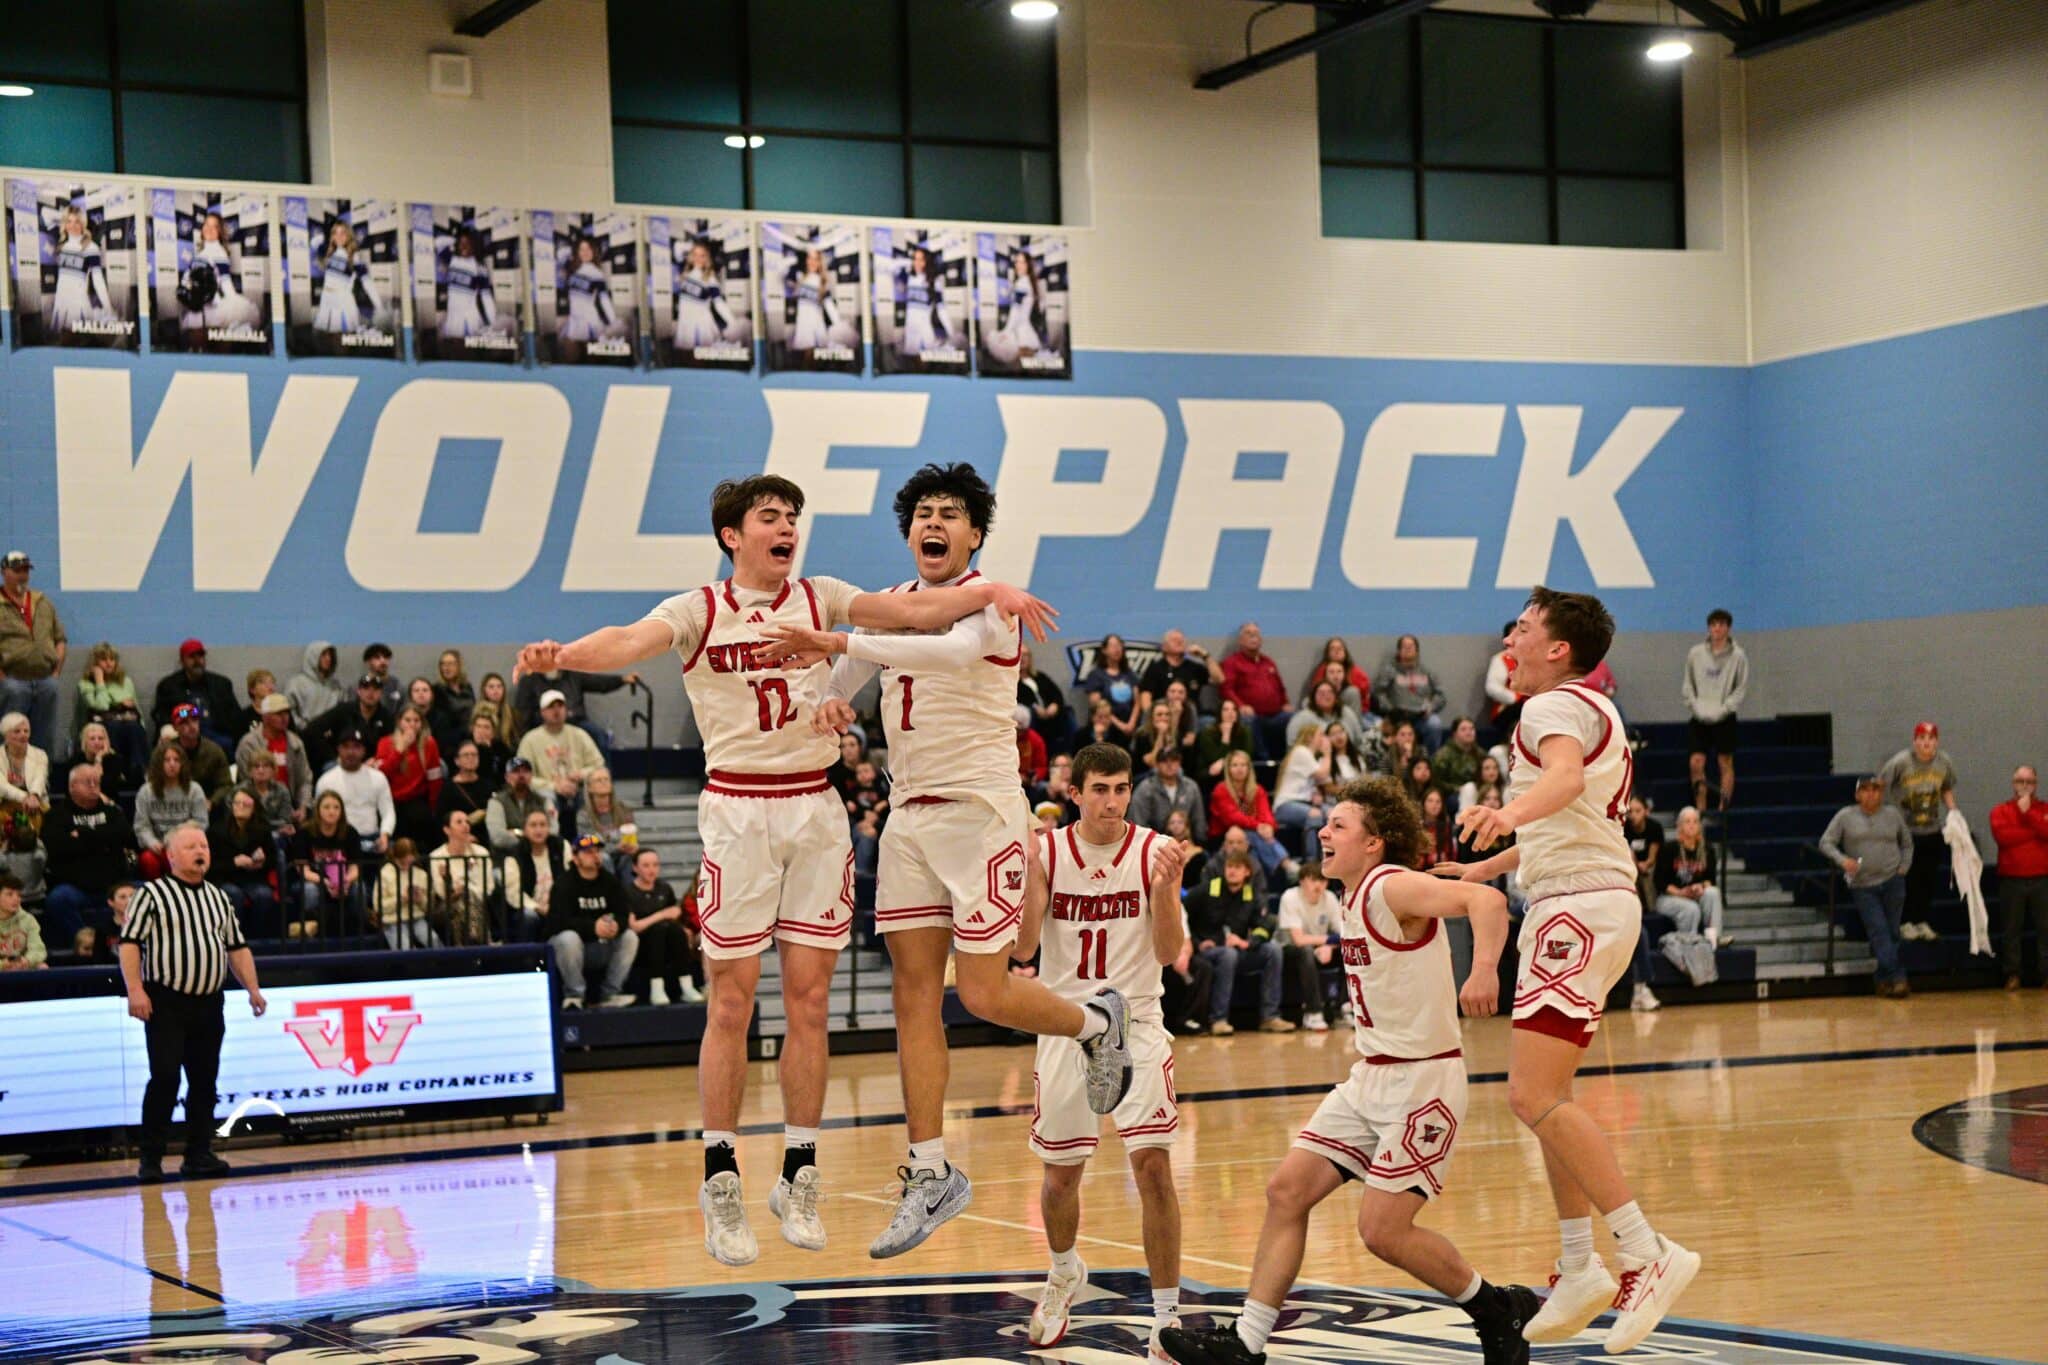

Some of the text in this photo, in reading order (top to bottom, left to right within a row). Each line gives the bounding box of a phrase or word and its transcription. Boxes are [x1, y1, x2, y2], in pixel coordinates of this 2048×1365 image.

[71, 320, 135, 335] MALLORY
[53, 367, 1685, 593] WOLF PACK
[747, 677, 798, 731] 12
[897, 674, 915, 731] 1
[1052, 890, 1140, 921] SKYROCKETS
[1076, 928, 1108, 979] 11
[250, 1085, 326, 1100] TEXAS
[336, 1081, 389, 1096] HIGH
[398, 1070, 536, 1092] COMANCHES
